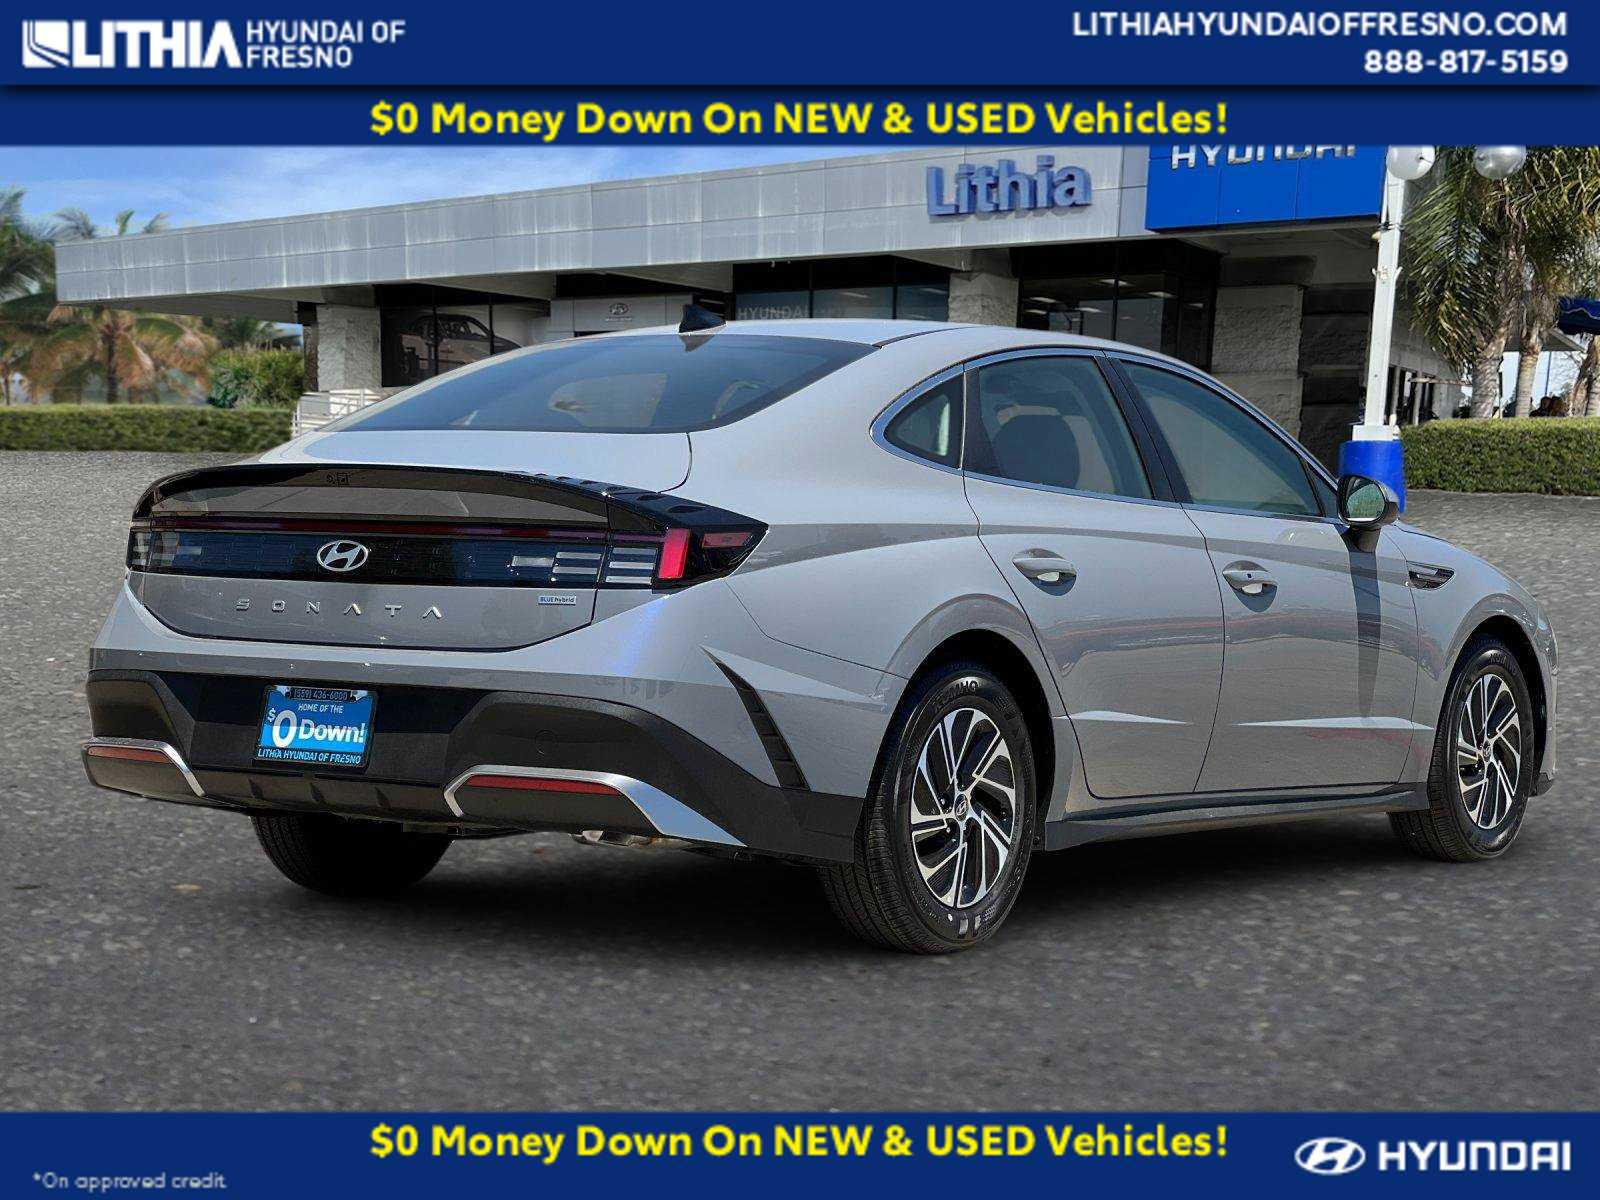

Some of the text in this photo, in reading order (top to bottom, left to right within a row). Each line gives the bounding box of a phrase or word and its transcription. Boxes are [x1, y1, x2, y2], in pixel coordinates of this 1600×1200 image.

[926, 155, 1092, 216] Lithia
[236, 598, 443, 619] SONATA
[298, 703, 344, 714] HOME OF THE
[300, 719, 366, 744] Down!
[257, 748, 362, 764] LITHIA HYUNDAI OF FRESNO
